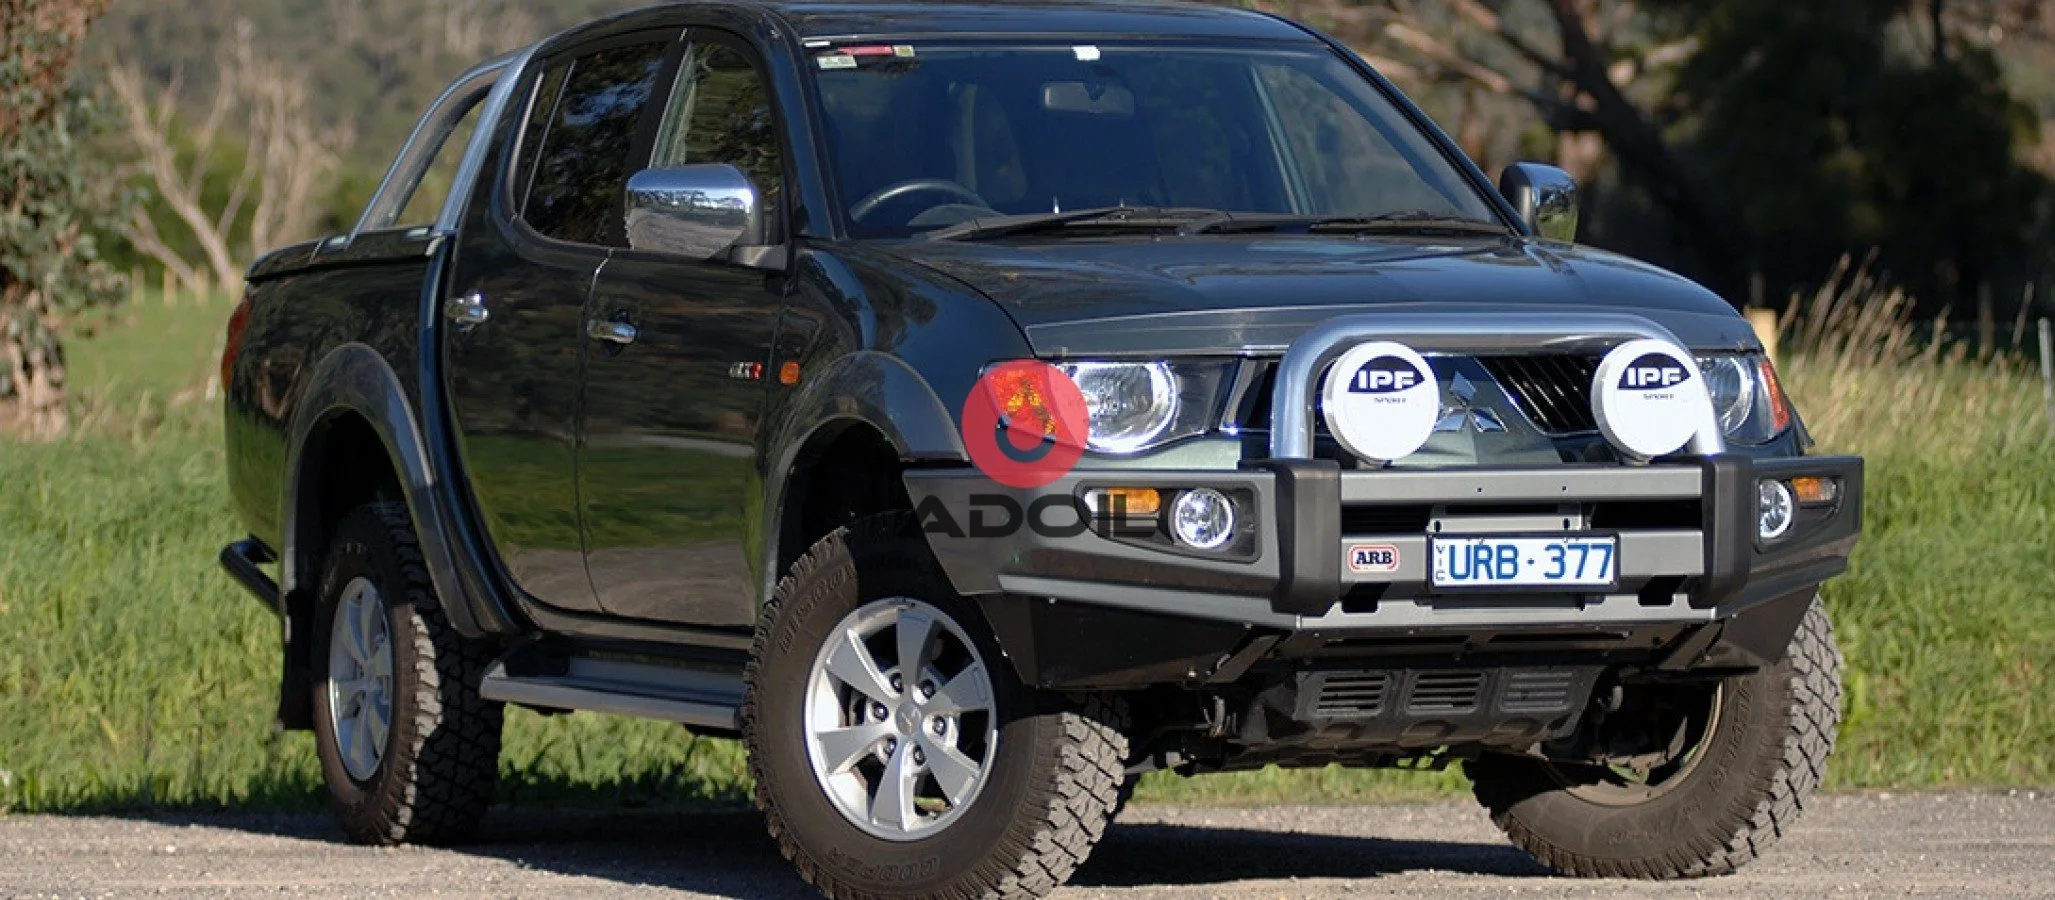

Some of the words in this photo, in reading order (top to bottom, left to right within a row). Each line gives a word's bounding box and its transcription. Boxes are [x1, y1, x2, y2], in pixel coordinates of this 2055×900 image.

[1357, 370, 1414, 389] IPF
[1627, 366, 1681, 386] IPF
[1355, 550, 1394, 566] ARB
